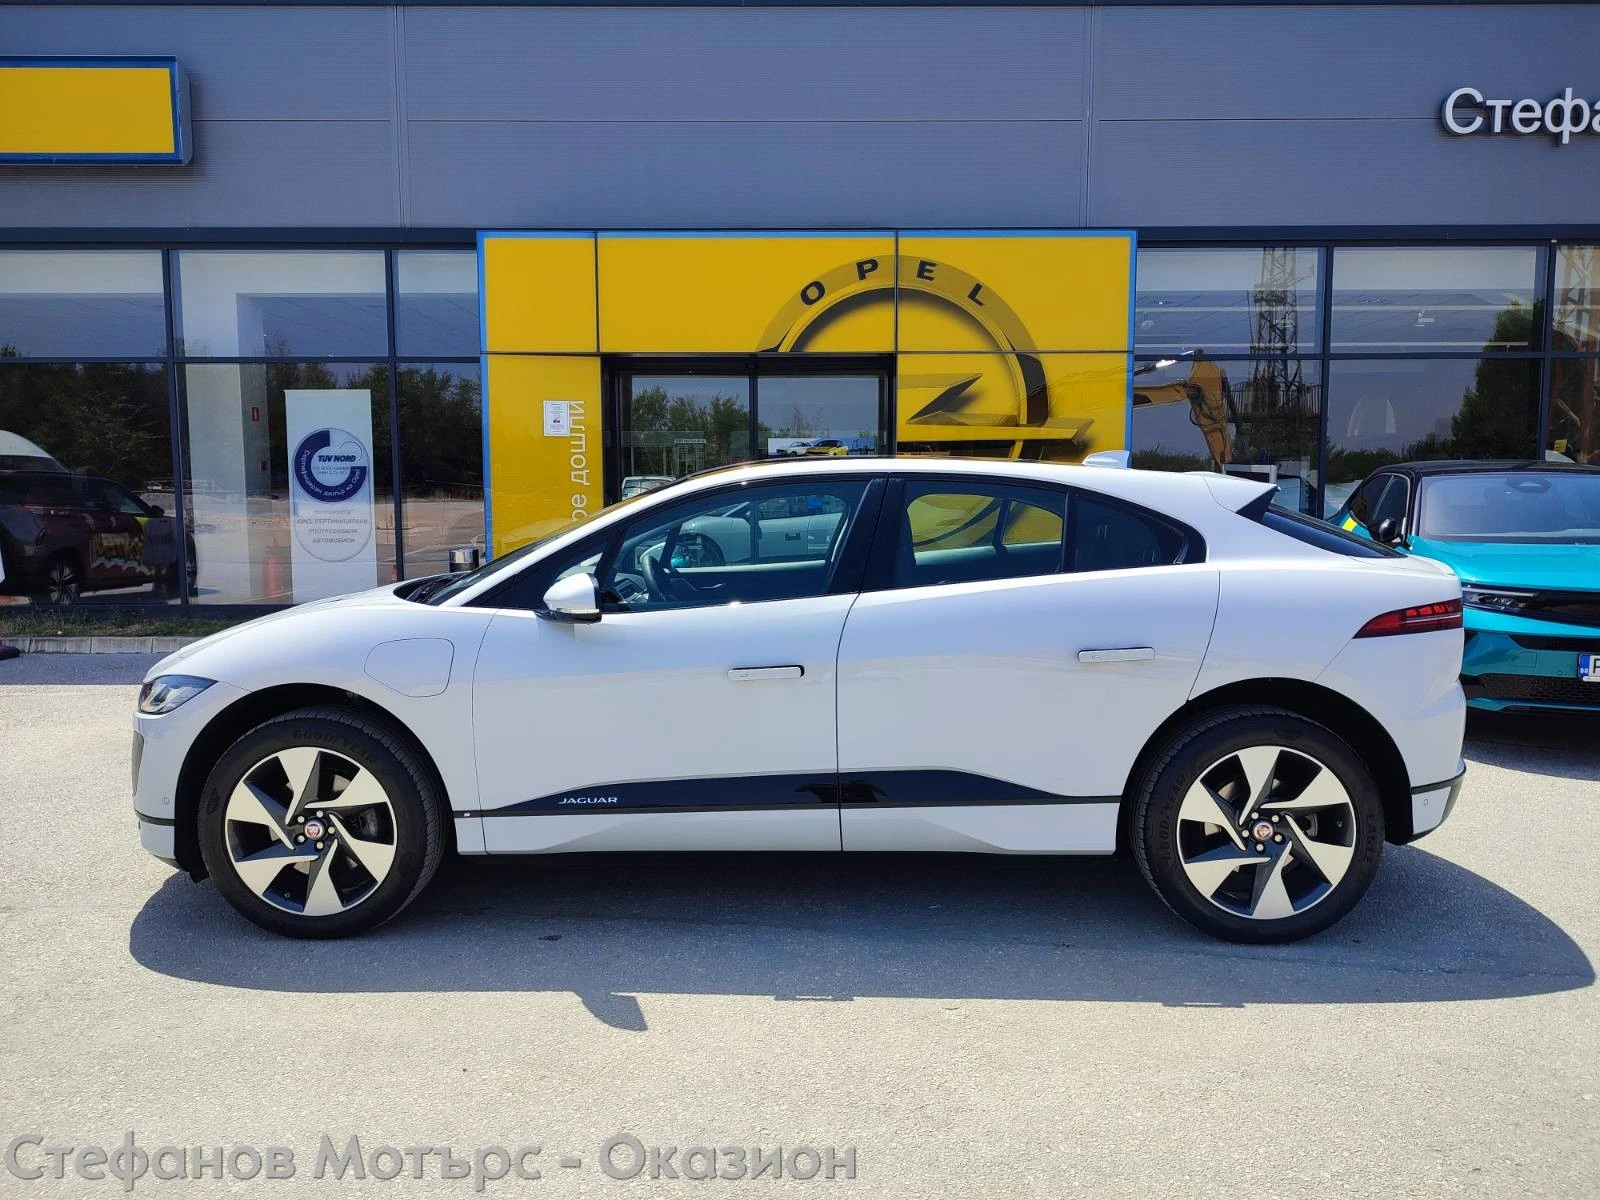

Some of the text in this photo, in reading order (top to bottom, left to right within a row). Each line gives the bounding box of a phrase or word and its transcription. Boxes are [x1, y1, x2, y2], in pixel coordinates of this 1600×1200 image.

[800, 258, 985, 307] OPEL
[569, 400, 591, 486] дошли
[334, 455, 356, 463] NORD
[558, 796, 618, 805] JAGUAR
